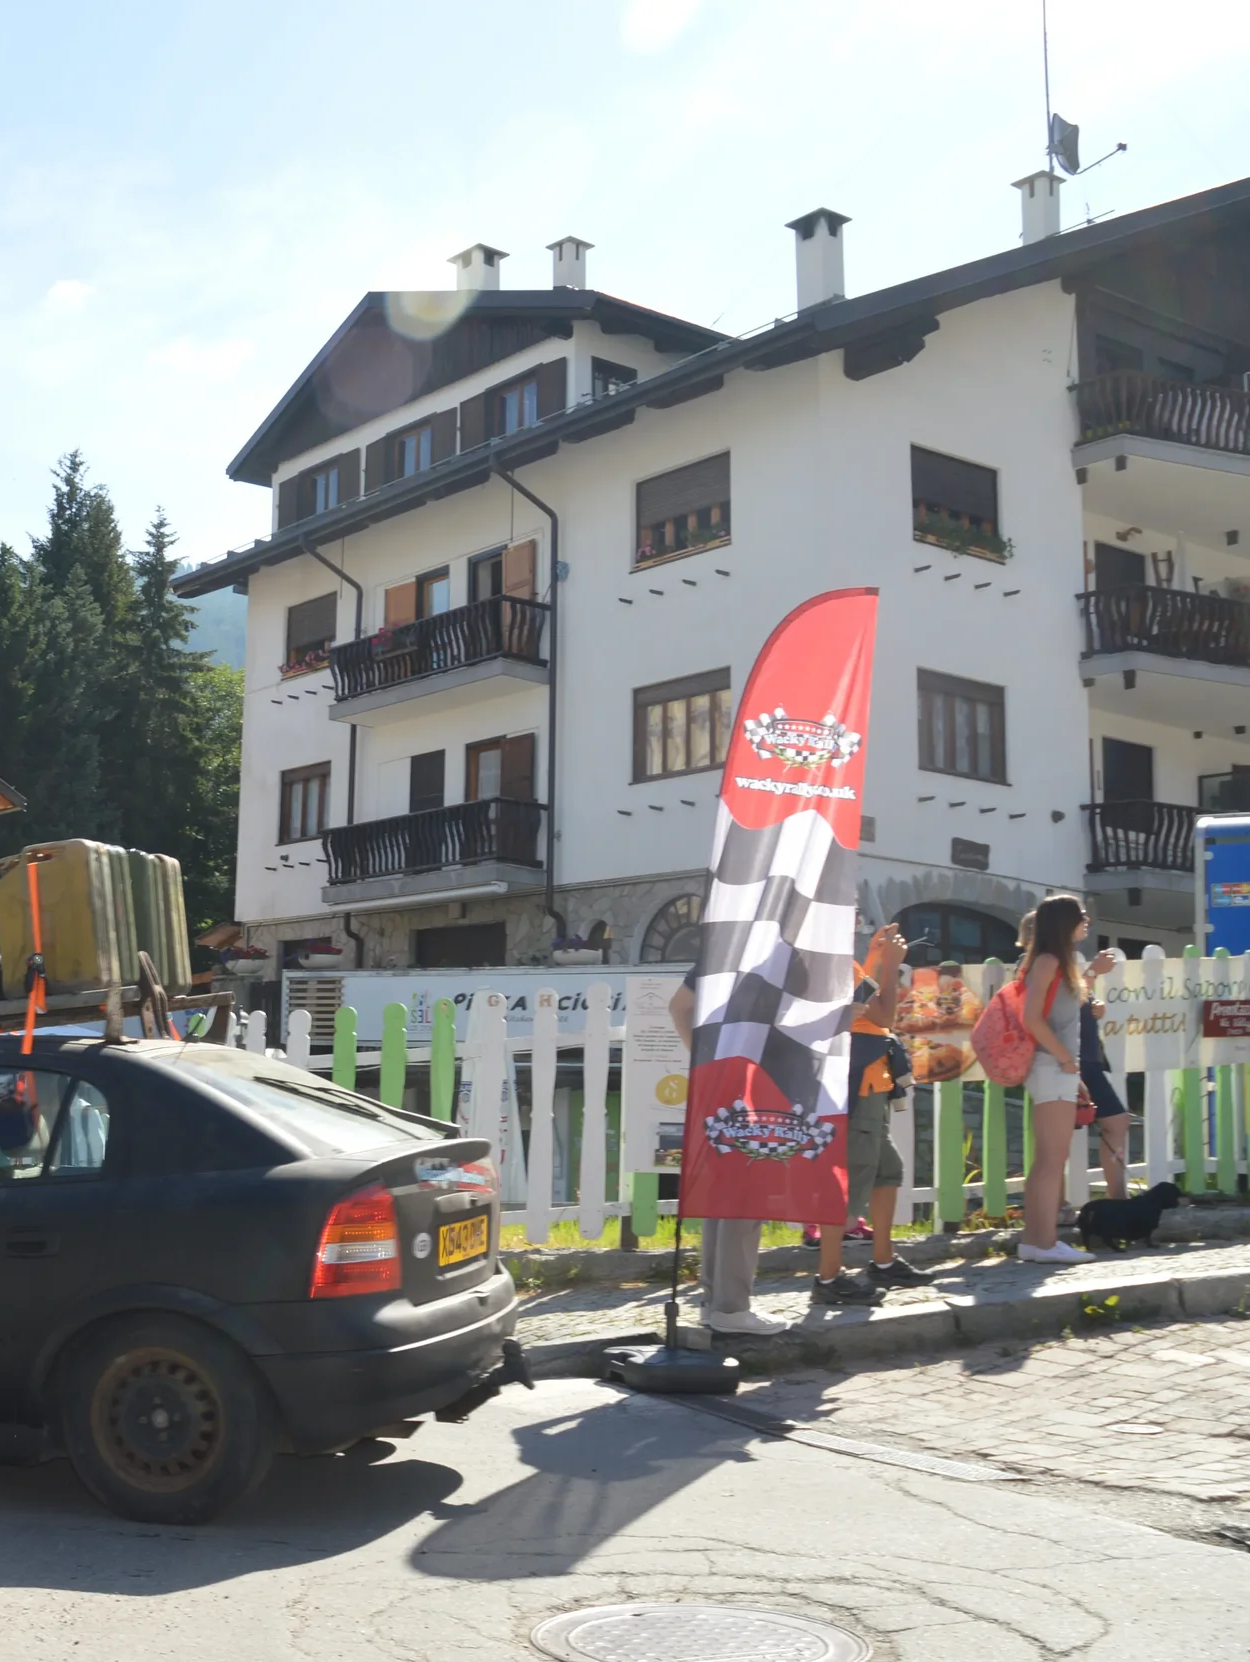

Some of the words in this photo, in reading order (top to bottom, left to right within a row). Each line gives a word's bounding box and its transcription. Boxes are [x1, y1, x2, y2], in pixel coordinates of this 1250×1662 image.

[1106, 986, 1156, 1003] con
[1160, 976, 1177, 1001] il
[722, 1124, 770, 1138] Wacky
[774, 1127, 811, 1144] Rally
